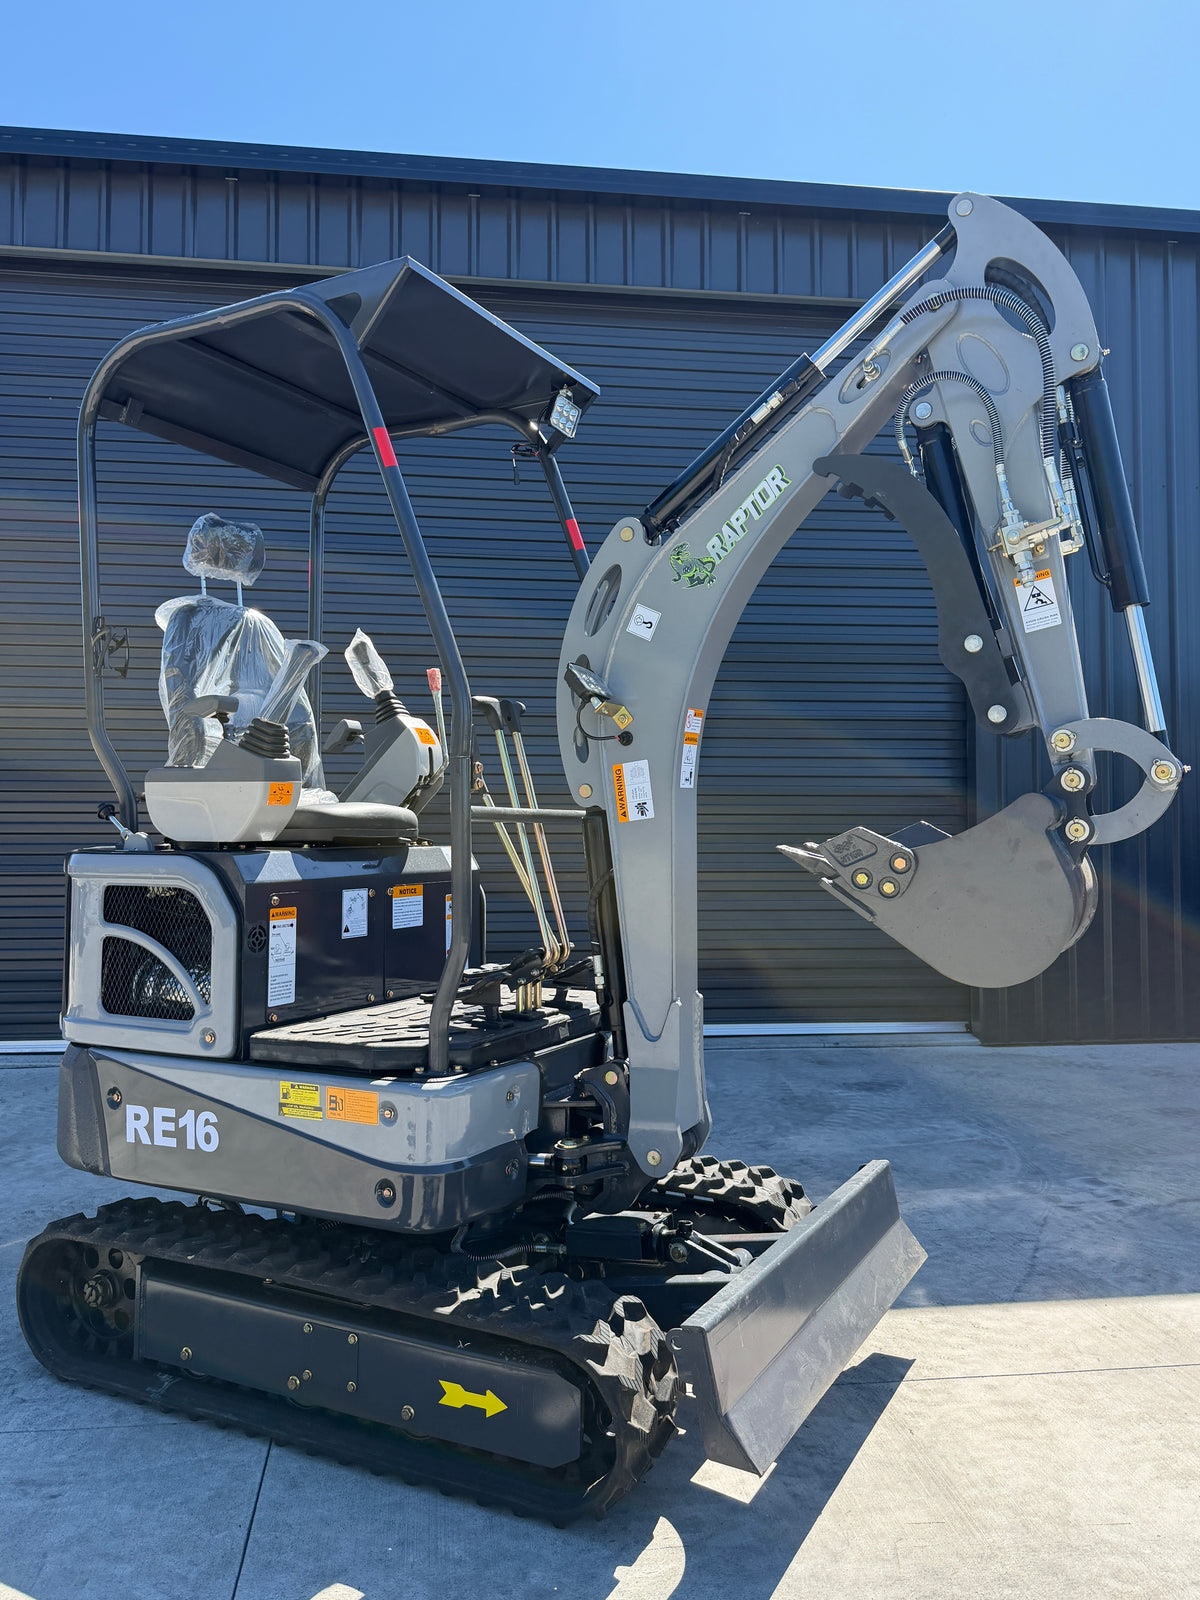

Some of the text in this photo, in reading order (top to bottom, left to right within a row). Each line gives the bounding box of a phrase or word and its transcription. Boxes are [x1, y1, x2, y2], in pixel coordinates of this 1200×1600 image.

[705, 464, 792, 565] RAPTOR
[615, 768, 626, 811] WARNING
[399, 887, 417, 895] NOTICE
[274, 909, 295, 918] WARNING
[126, 1104, 219, 1152] RE16
